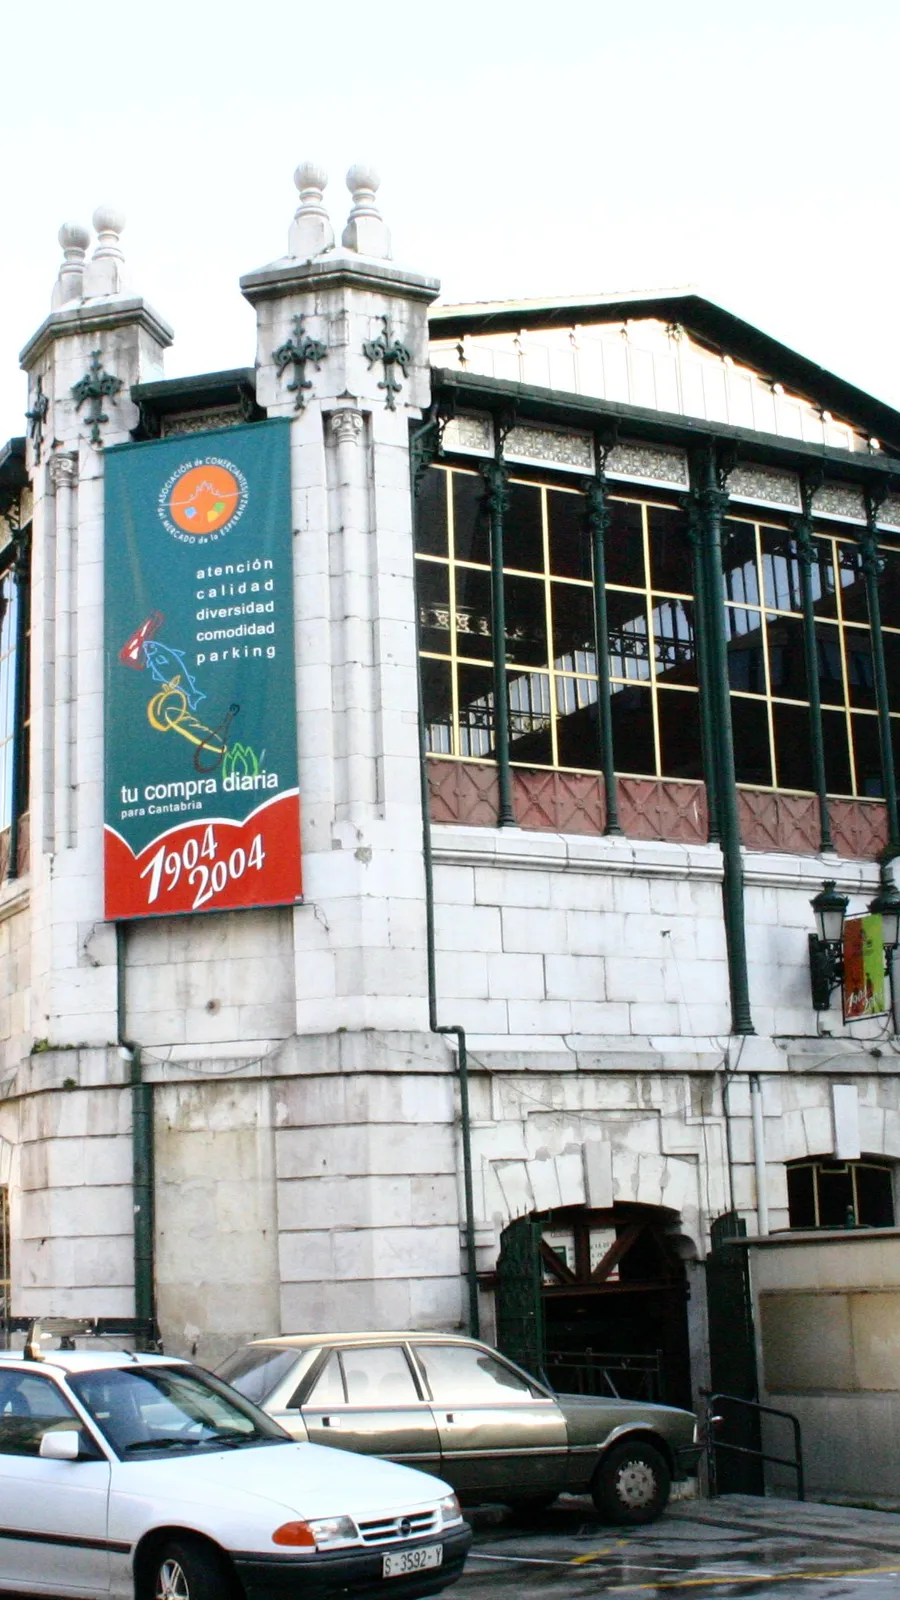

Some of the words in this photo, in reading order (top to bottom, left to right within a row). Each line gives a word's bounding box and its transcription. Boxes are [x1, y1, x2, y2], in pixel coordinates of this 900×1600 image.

[158, 462, 193, 504] ASOCIACIÓN
[194, 458, 203, 467] de
[205, 456, 249, 491] COMERCIANTES
[162, 520, 196, 544] MERCADO
[198, 534, 208, 544] de
[219, 493, 249, 536] ESPERANZA
[196, 558, 274, 580] atención
[196, 579, 274, 600] calidad
[196, 600, 274, 621] diversidad
[196, 622, 275, 642] comodidad
[196, 645, 276, 666] parking
[121, 785, 138, 803] tu
[144, 777, 217, 800] compra
[222, 769, 279, 792] diaria
[120, 807, 145, 820] para
[148, 800, 203, 815] Cantabria
[140, 824, 218, 905] 1904
[188, 833, 266, 910] 2004
